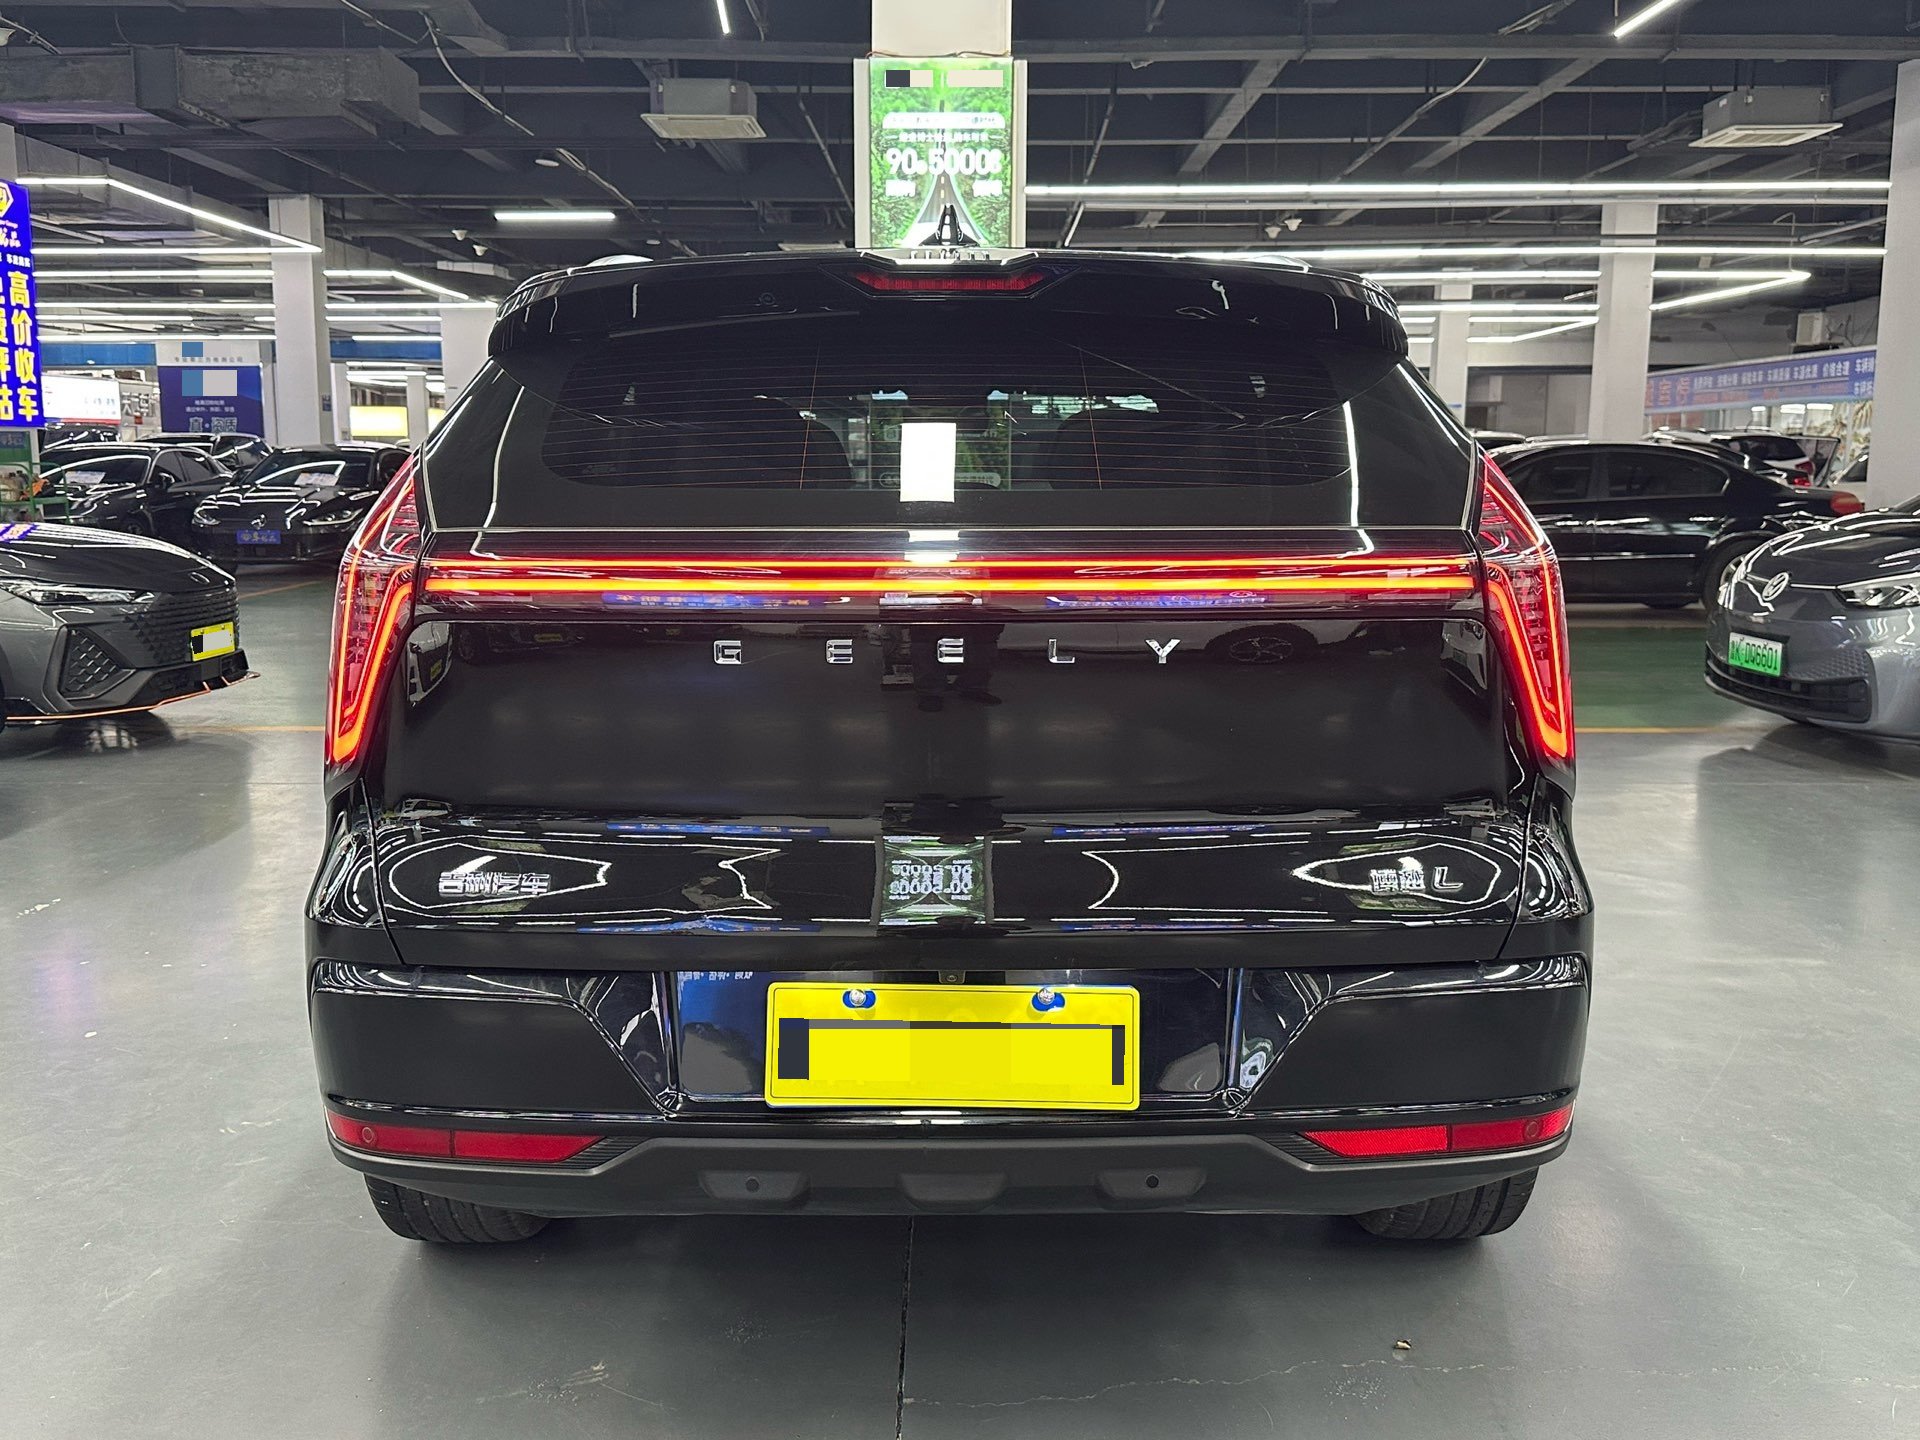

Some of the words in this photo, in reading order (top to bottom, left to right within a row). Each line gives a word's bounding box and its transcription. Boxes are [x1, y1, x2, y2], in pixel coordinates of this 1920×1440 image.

[7, 271, 38, 422] 高价收车
[713, 638, 1181, 665] GEELY
[438, 871, 550, 896] 吉利汽车
